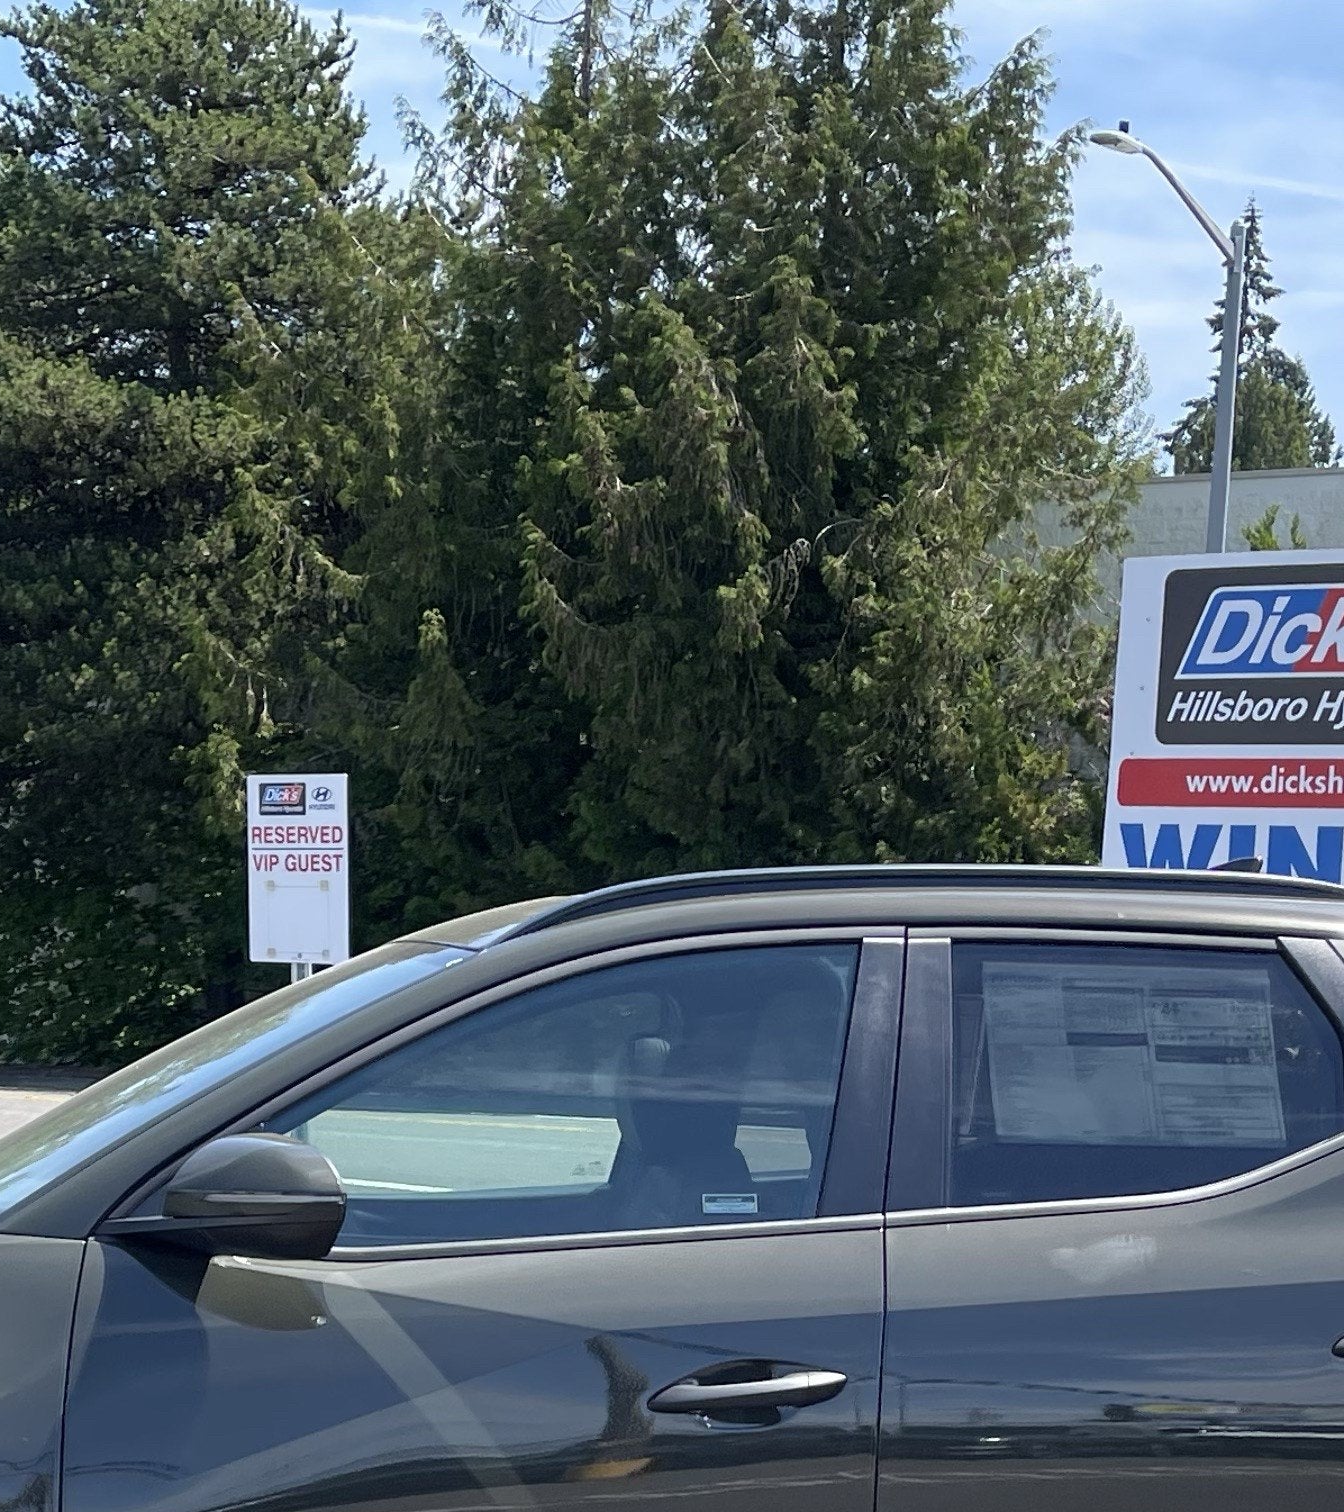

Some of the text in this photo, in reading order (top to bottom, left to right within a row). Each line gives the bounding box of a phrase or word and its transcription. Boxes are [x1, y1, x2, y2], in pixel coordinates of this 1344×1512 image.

[1167, 690, 1309, 724] Hillsboro
[251, 826, 344, 844] RESERVED
[253, 854, 344, 872] VIP GUEST
